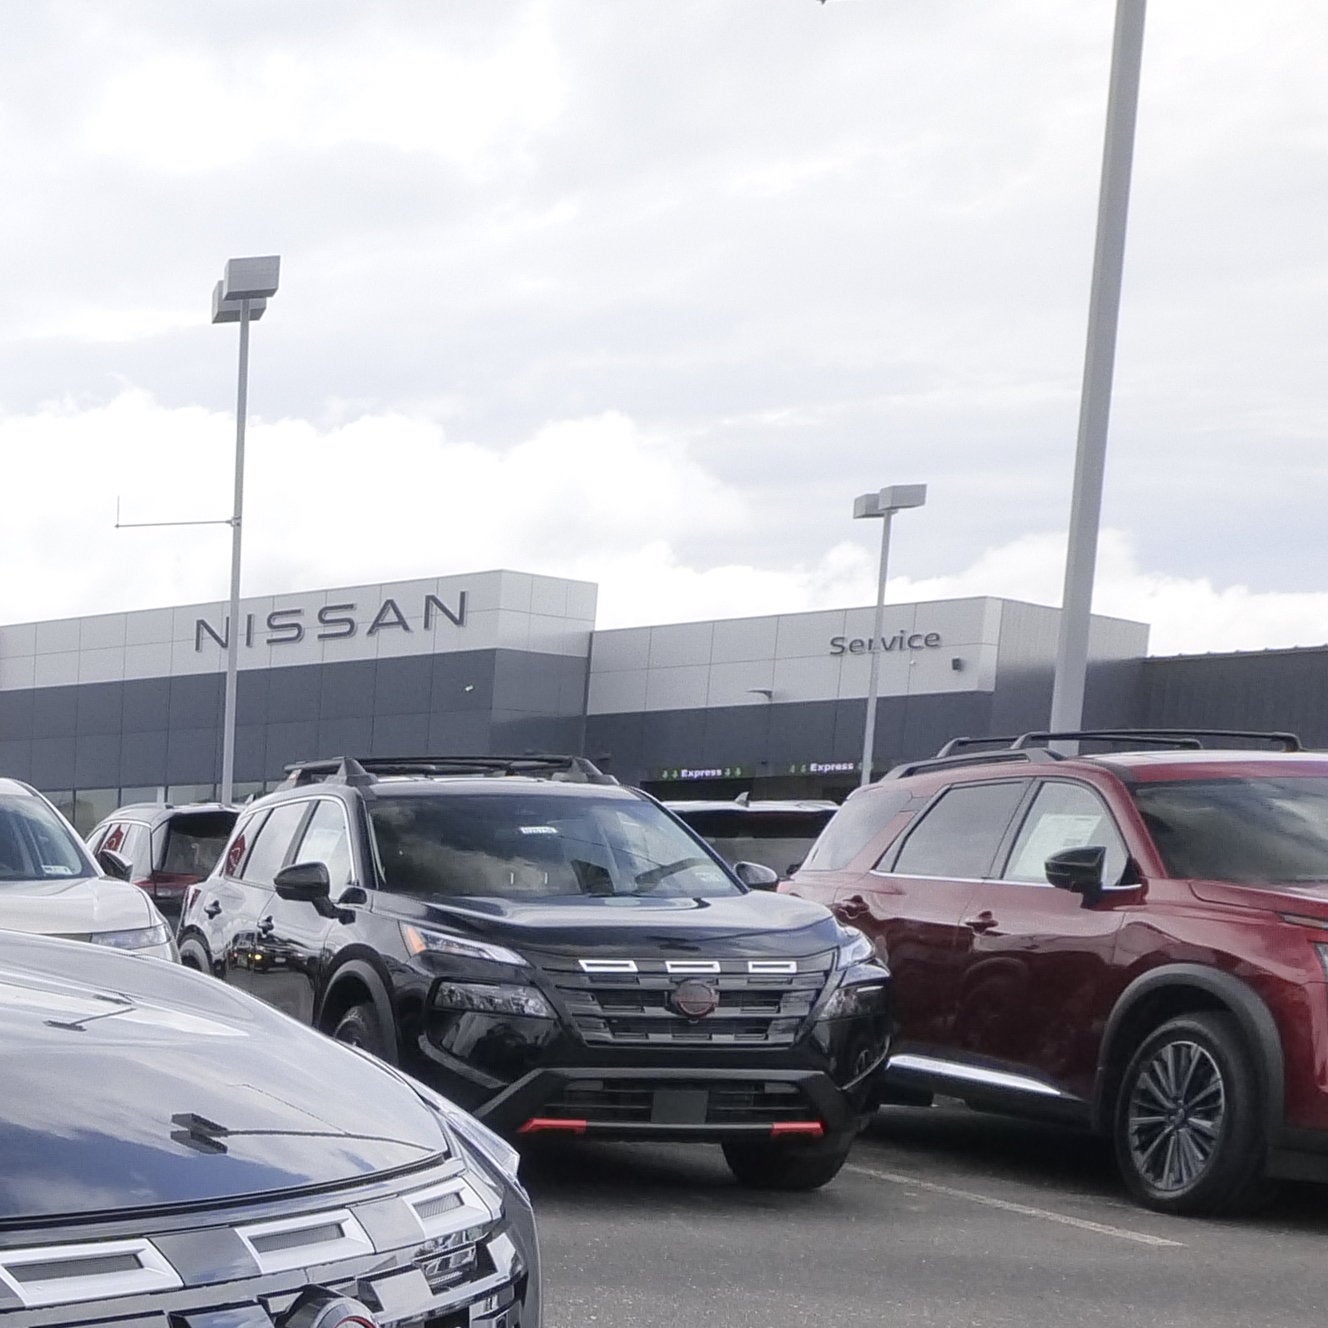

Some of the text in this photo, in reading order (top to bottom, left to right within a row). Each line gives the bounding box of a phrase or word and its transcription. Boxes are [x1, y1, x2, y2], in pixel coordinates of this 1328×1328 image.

[195, 590, 469, 652] NISSAN
[829, 629, 941, 656] Service
[681, 768, 722, 779] Express
[810, 762, 854, 773] Express
